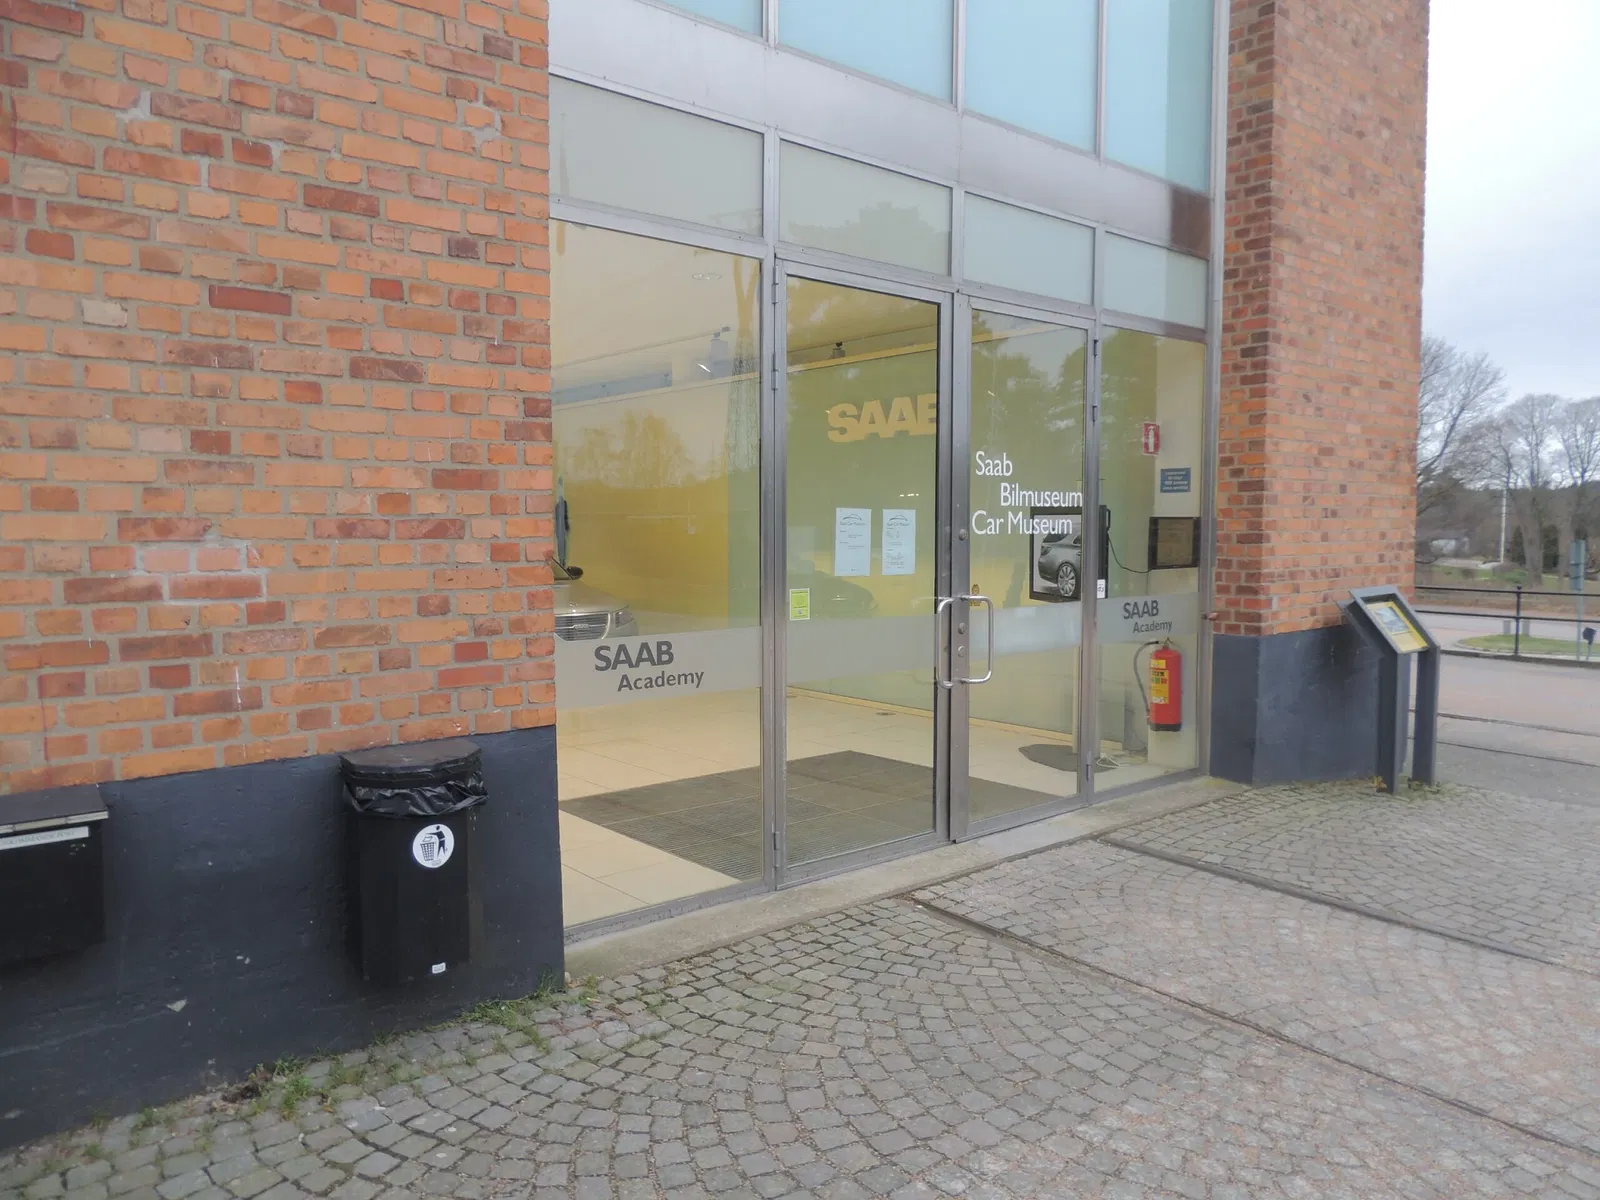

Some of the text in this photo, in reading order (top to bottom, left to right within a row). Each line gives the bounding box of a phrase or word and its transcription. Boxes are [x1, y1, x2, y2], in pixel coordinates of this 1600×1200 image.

[975, 450, 1013, 476] Saab
[1000, 482, 1082, 507] Bilmuseum
[972, 510, 1073, 535] Car Museum
[1123, 599, 1159, 620] SAAB
[1132, 620, 1173, 634] Academy
[594, 640, 674, 672] SAAB
[617, 670, 705, 692] Academy
